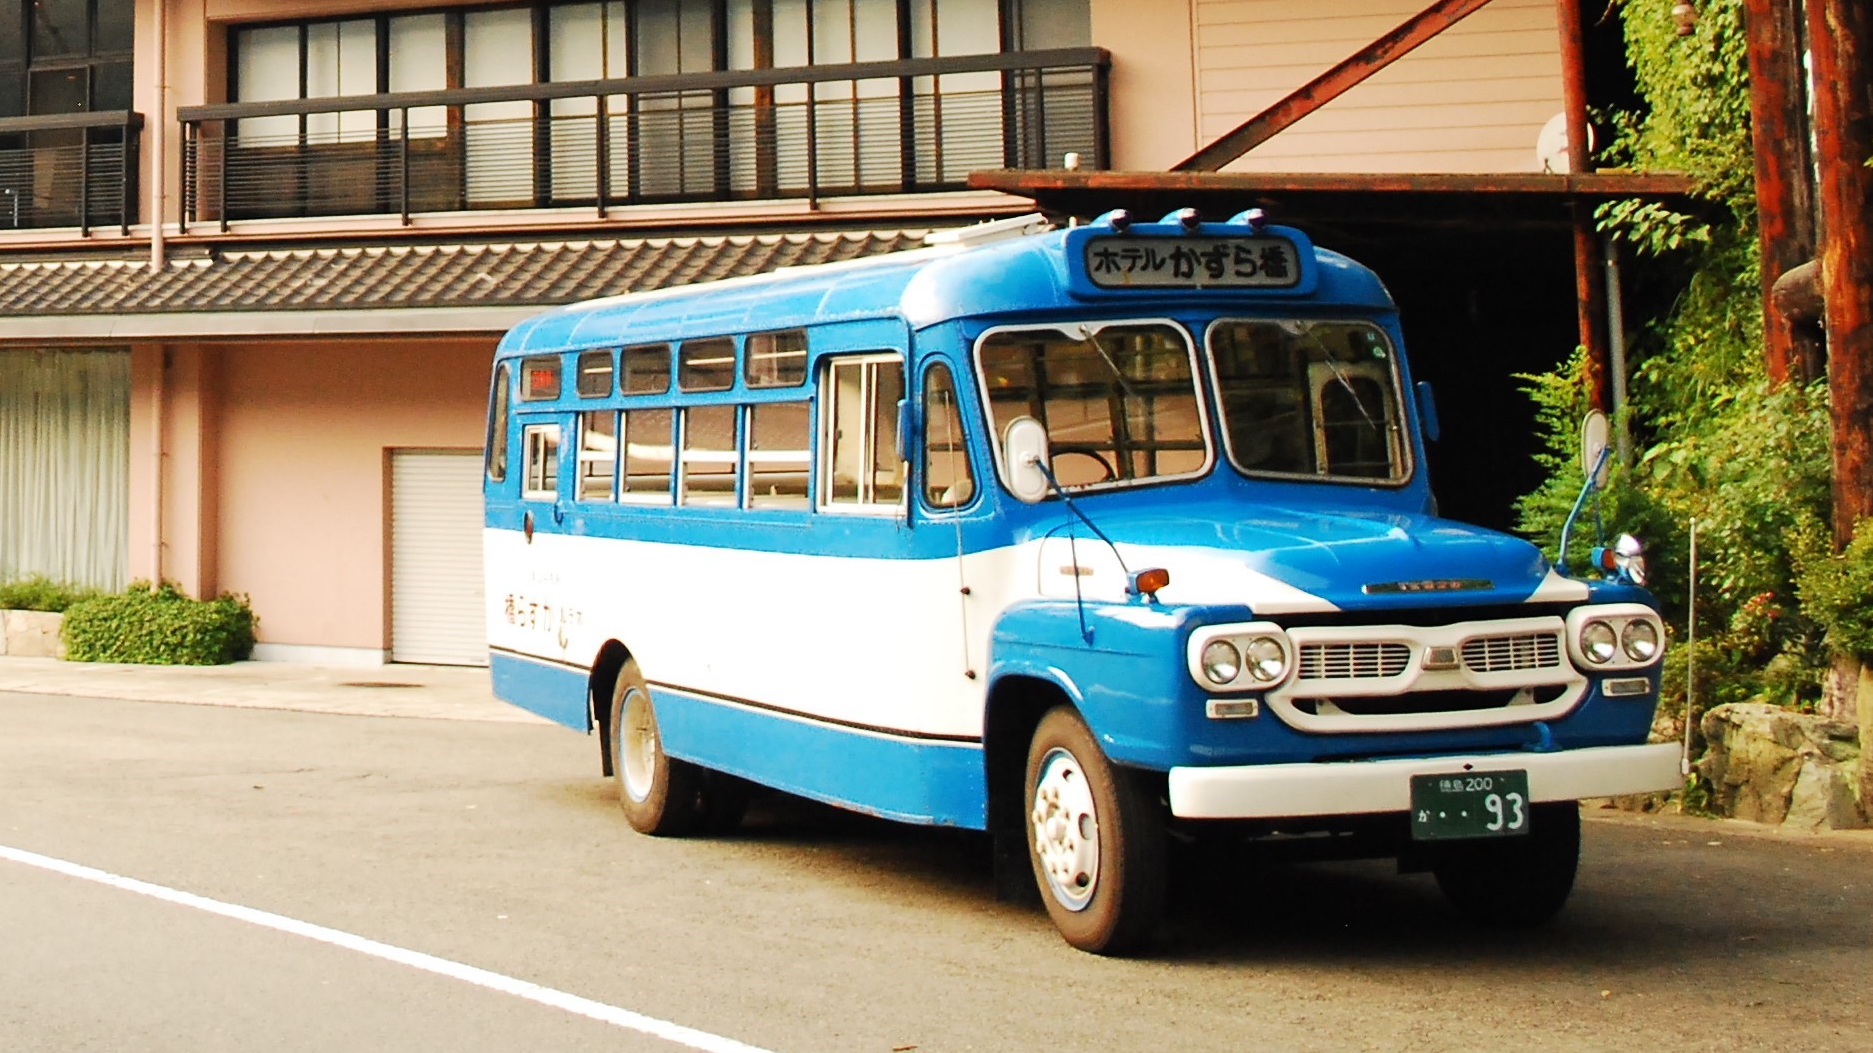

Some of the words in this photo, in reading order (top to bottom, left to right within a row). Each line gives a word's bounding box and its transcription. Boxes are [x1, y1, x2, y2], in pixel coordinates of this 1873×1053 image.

[1093, 244, 1289, 279] ホテルかずら橋
[1466, 777, 1493, 791] 200
[1484, 792, 1524, 831] 93
